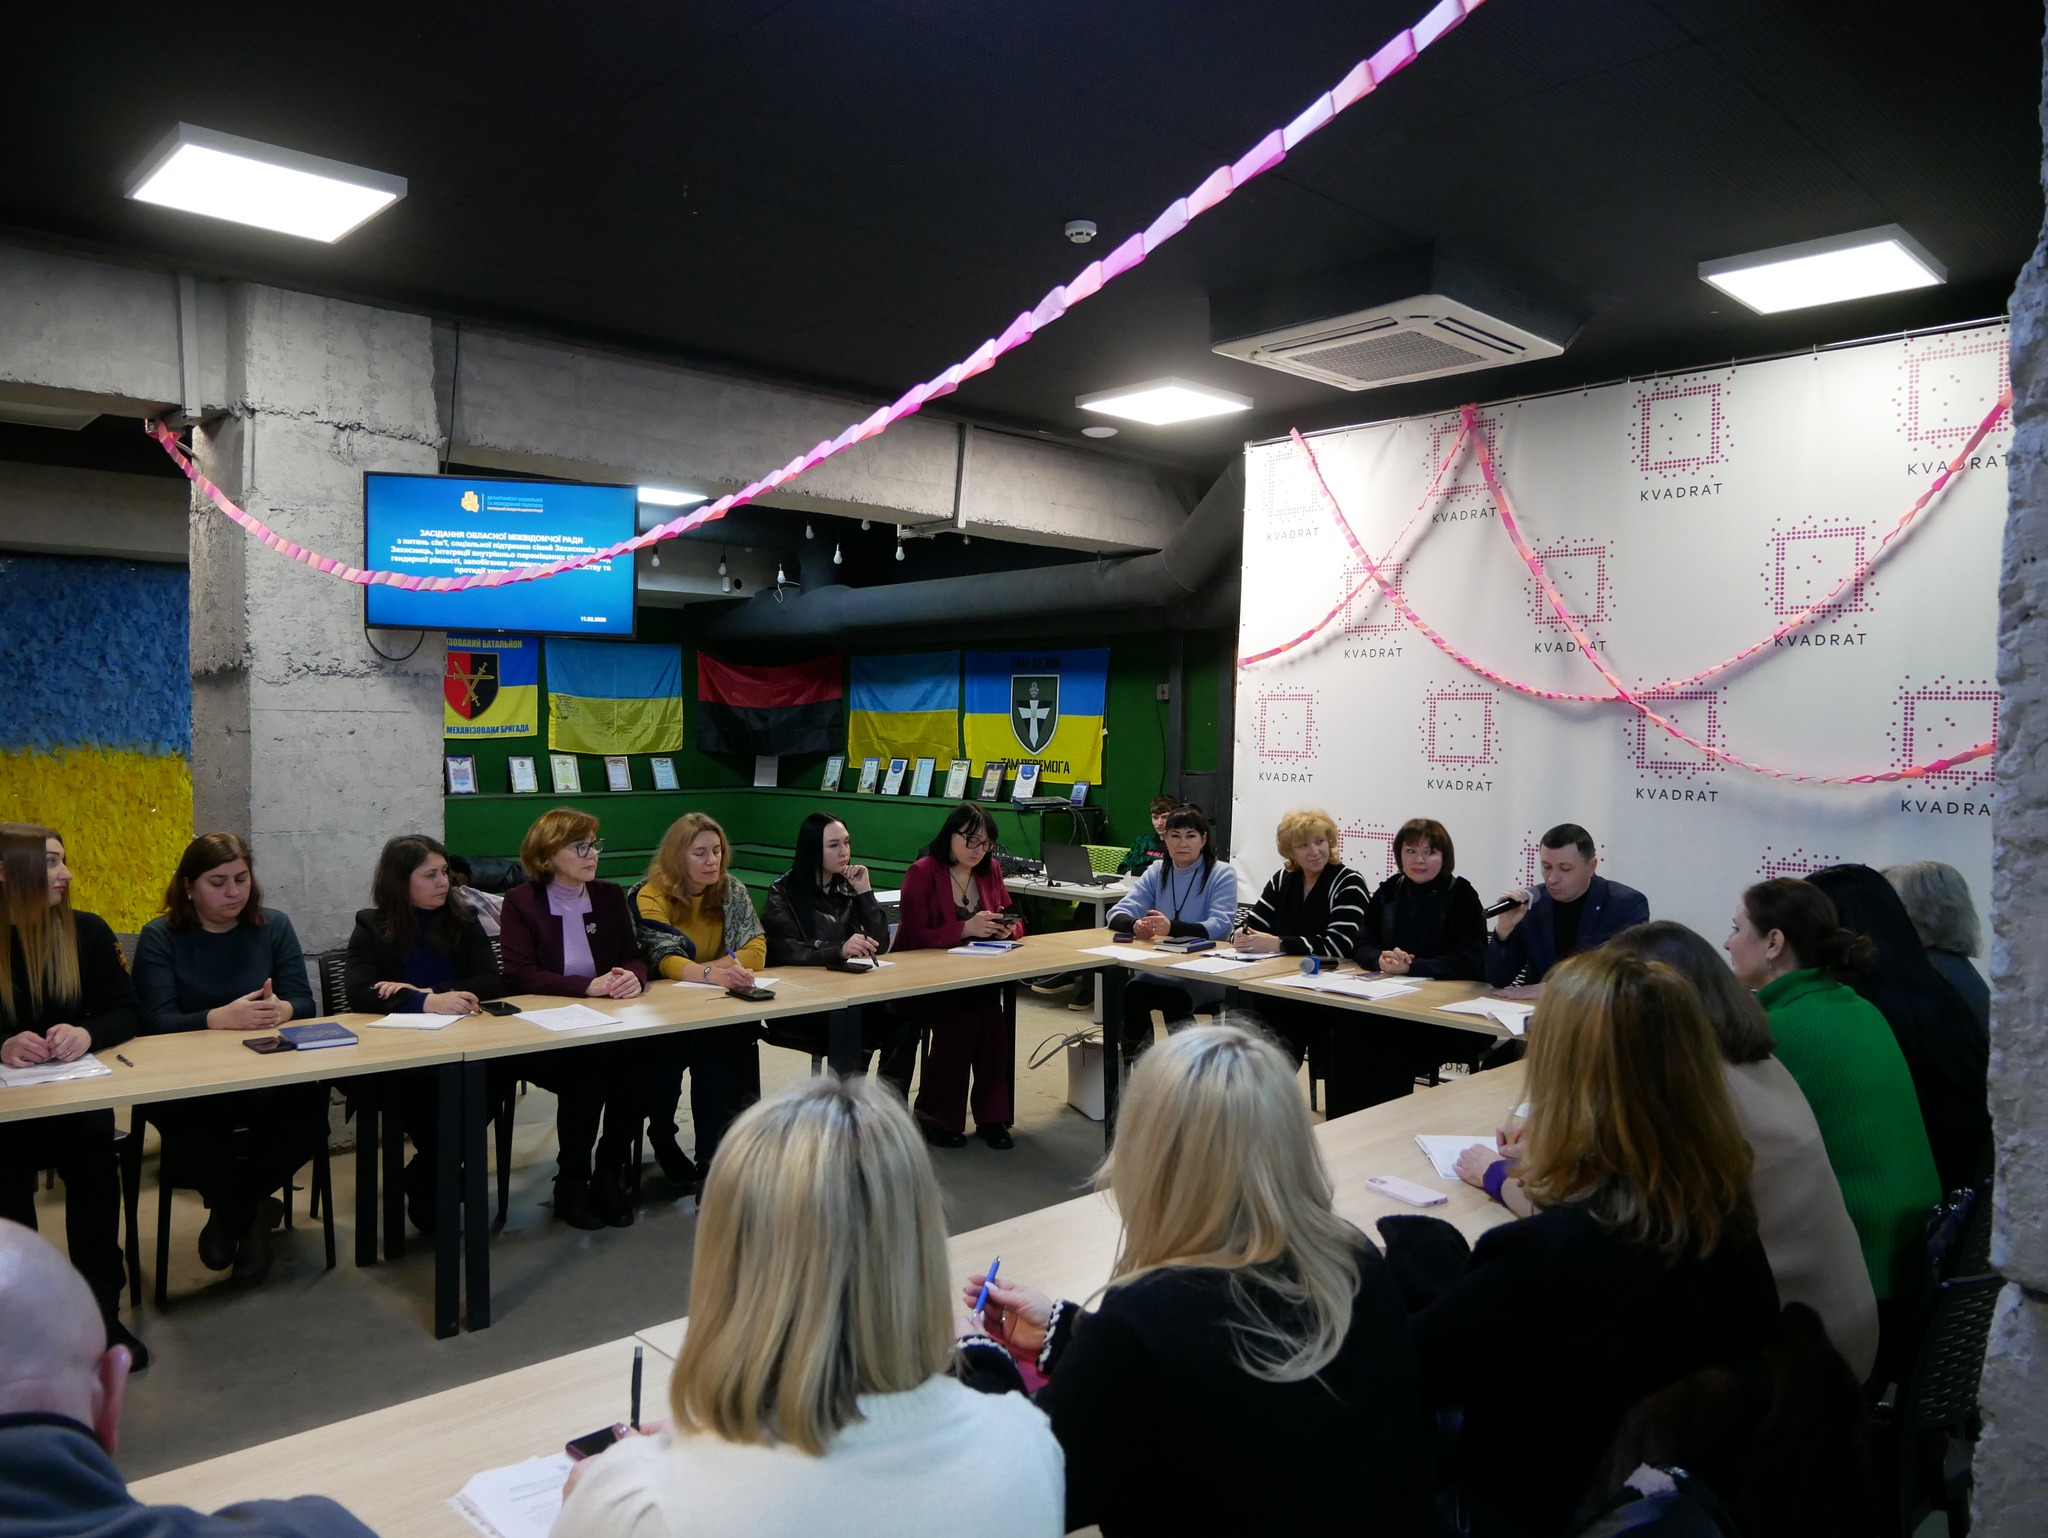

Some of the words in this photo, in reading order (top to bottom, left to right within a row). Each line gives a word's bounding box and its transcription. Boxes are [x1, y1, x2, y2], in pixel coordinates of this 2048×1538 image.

[1907, 454, 2009, 475] KVARAT
[1641, 483, 1723, 501] KVADRAT
[1432, 507, 1497, 523] KVADRAT
[420, 529, 464, 539] ЗАСІДАННЯ
[466, 531, 506, 541] ОБЛАСНОЇ
[508, 533, 561, 544] МІЖВІДОМЧОЇ
[562, 537, 584, 545] РАДИ
[1266, 527, 1319, 540] KVADRAT
[435, 548, 471, 557] інтеграції
[451, 540, 492, 548] соціальної
[493, 542, 531, 551] підтримки
[555, 545, 596, 553] Захисників
[463, 558, 508, 566] запобігання
[446, 638, 481, 648] ЗОВАНИЙ
[482, 639, 522, 649] БАТАЛЬЙОН
[1774, 633, 1868, 647] KVADRAT
[1345, 648, 1403, 659] KVADRAT
[1010, 657, 1030, 671] ТАМ
[1031, 656, 1044, 671] ДЕ
[1045, 656, 1061, 670] МИ
[446, 725, 499, 735] МЕХАНІЗОВАНА
[501, 724, 530, 734] БРИГАДА
[1259, 771, 1313, 783] KVADRAT
[1427, 779, 1493, 792] KVADRAT
[1636, 787, 1719, 802] KVADRAT
[1901, 800, 1993, 816] KVADRA
